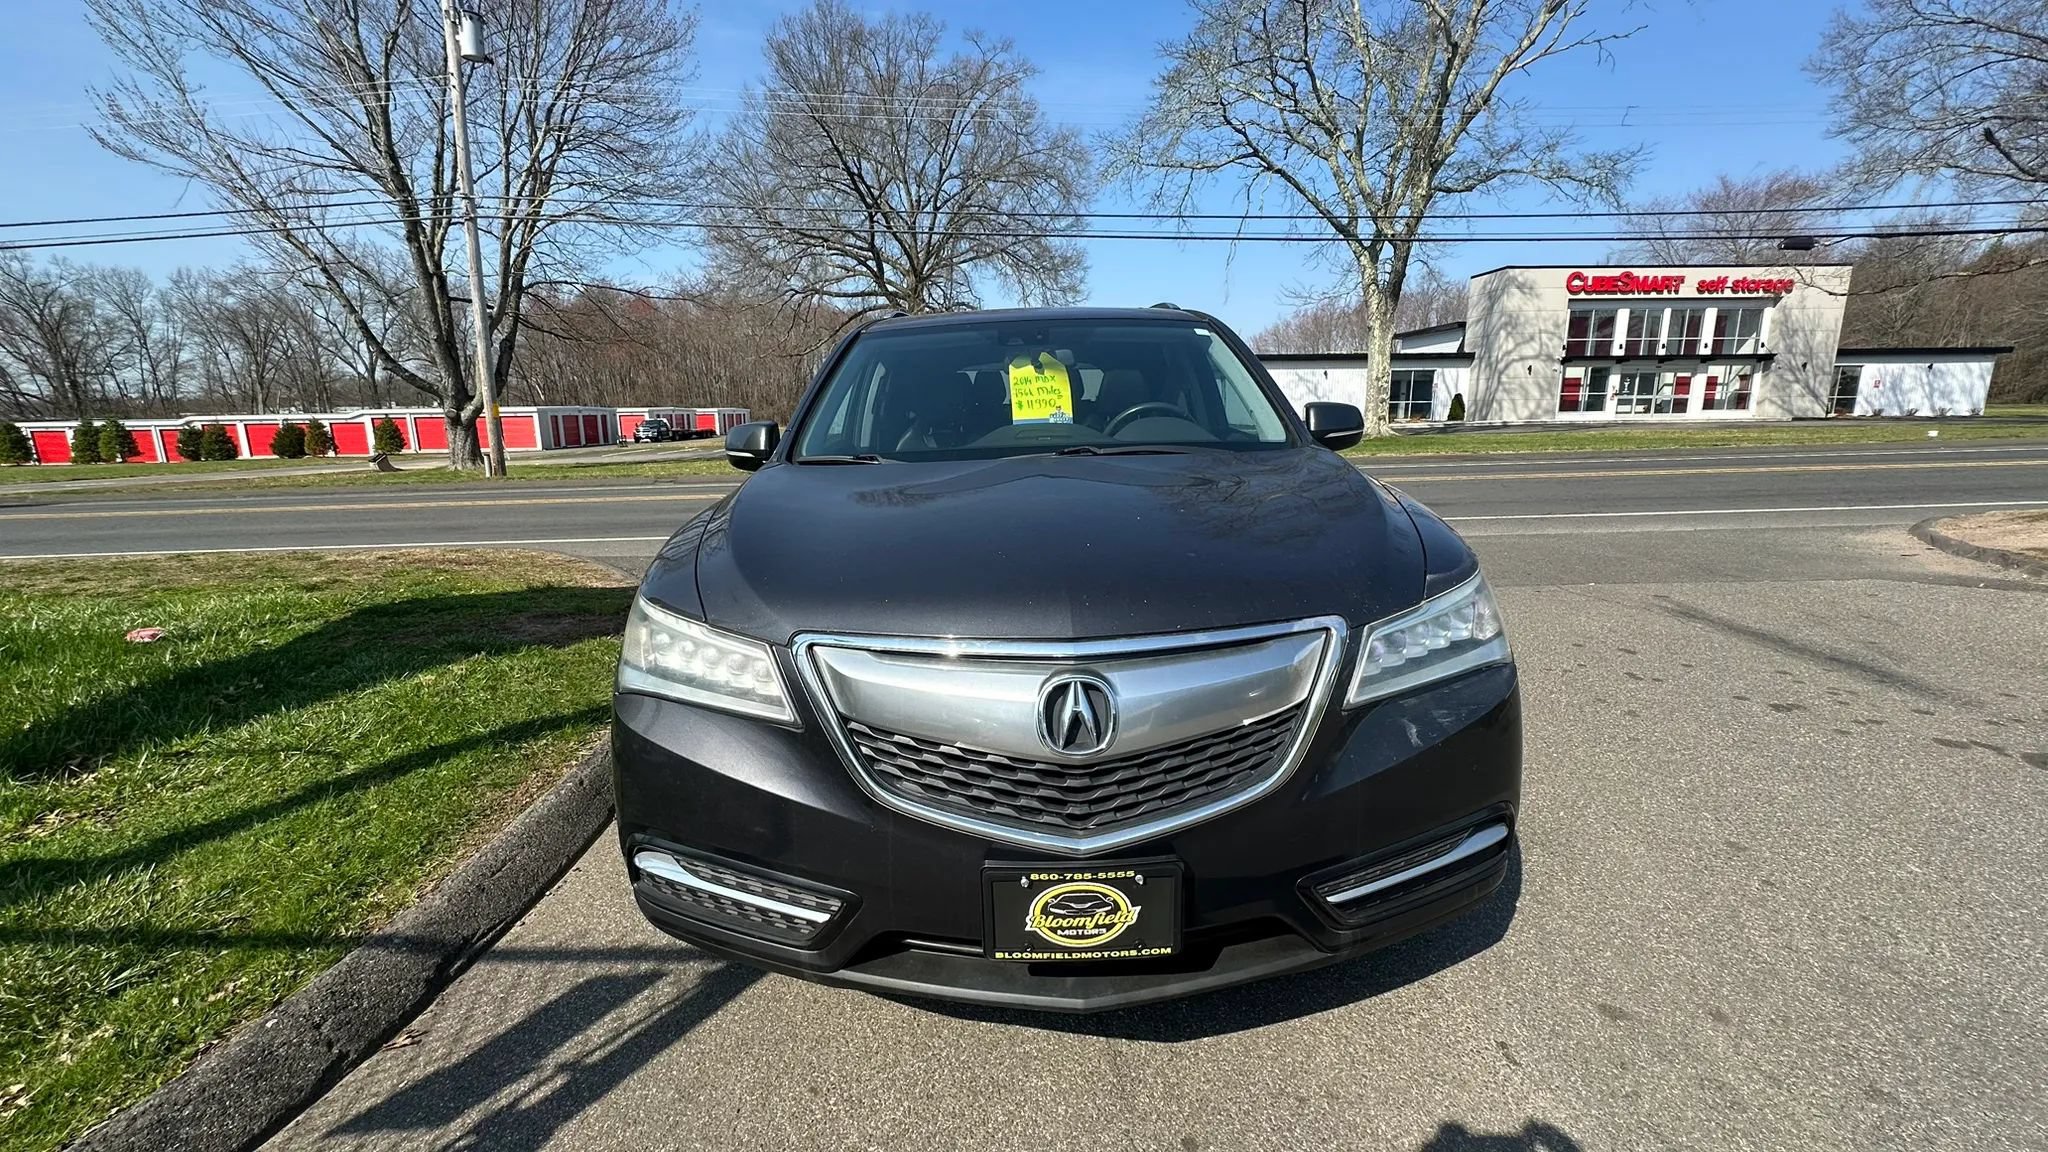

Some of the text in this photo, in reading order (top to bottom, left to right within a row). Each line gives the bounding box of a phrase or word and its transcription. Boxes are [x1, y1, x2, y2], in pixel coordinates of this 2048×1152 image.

[1696, 276, 1729, 295] self
[1731, 276, 1795, 296] storage
[1029, 870, 1136, 881] 860-785-5555
[1030, 909, 1135, 929] Bloomfield
[994, 947, 1172, 959] BLOOMFIELDMOTORS.COM
